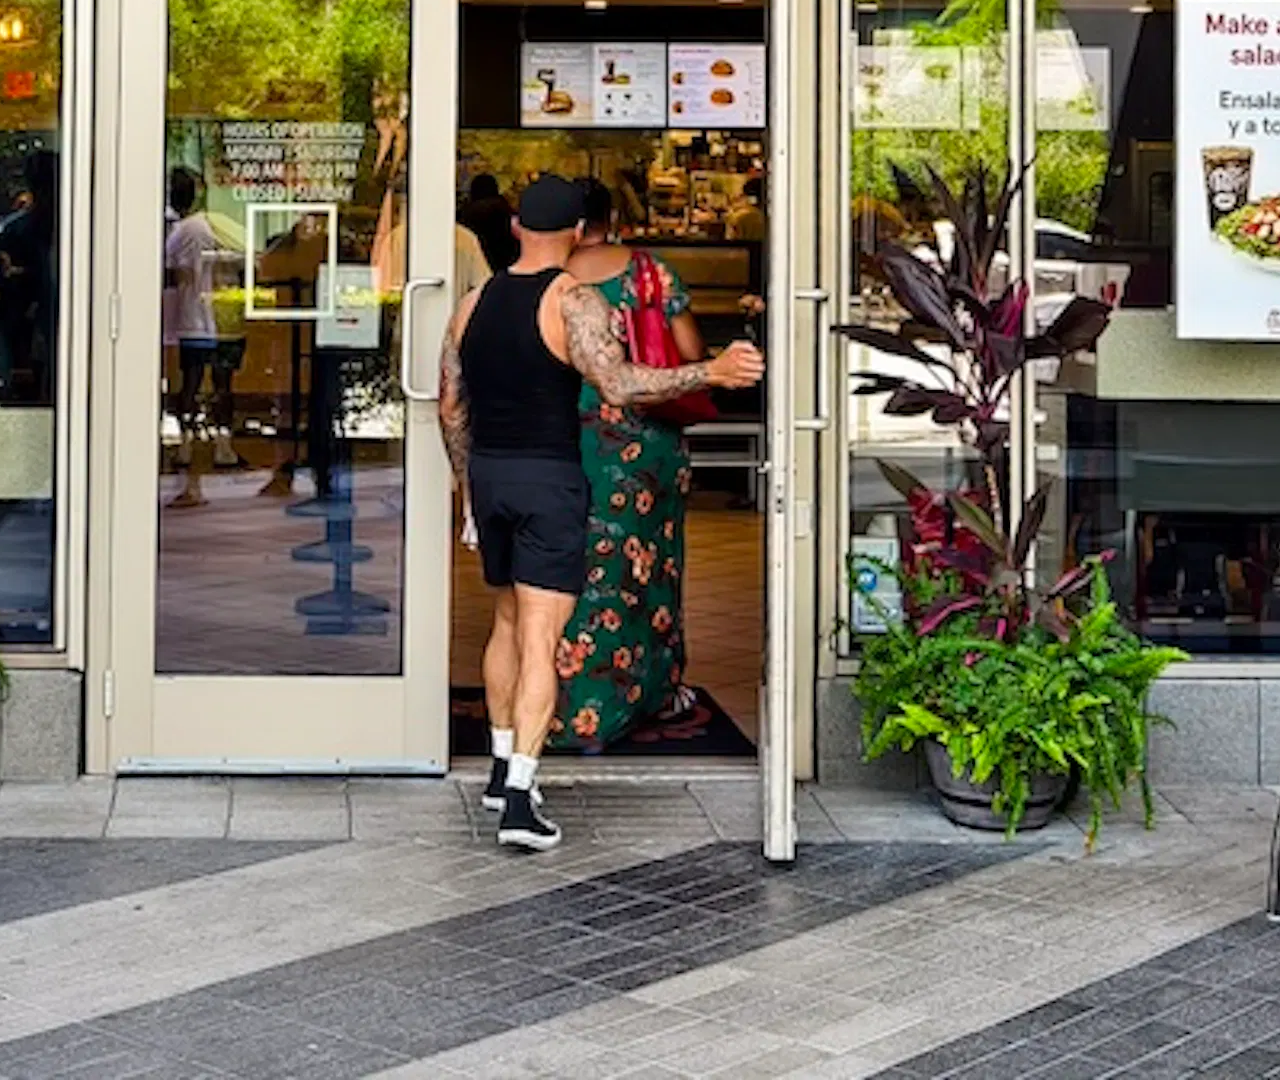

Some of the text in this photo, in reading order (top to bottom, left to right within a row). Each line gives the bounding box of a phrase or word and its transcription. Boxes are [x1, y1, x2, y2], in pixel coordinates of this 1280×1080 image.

[1205, 13, 1268, 35] Make
[222, 121, 269, 138] HOURS
[1228, 119, 1241, 139] y
[1245, 120, 1258, 134] a
